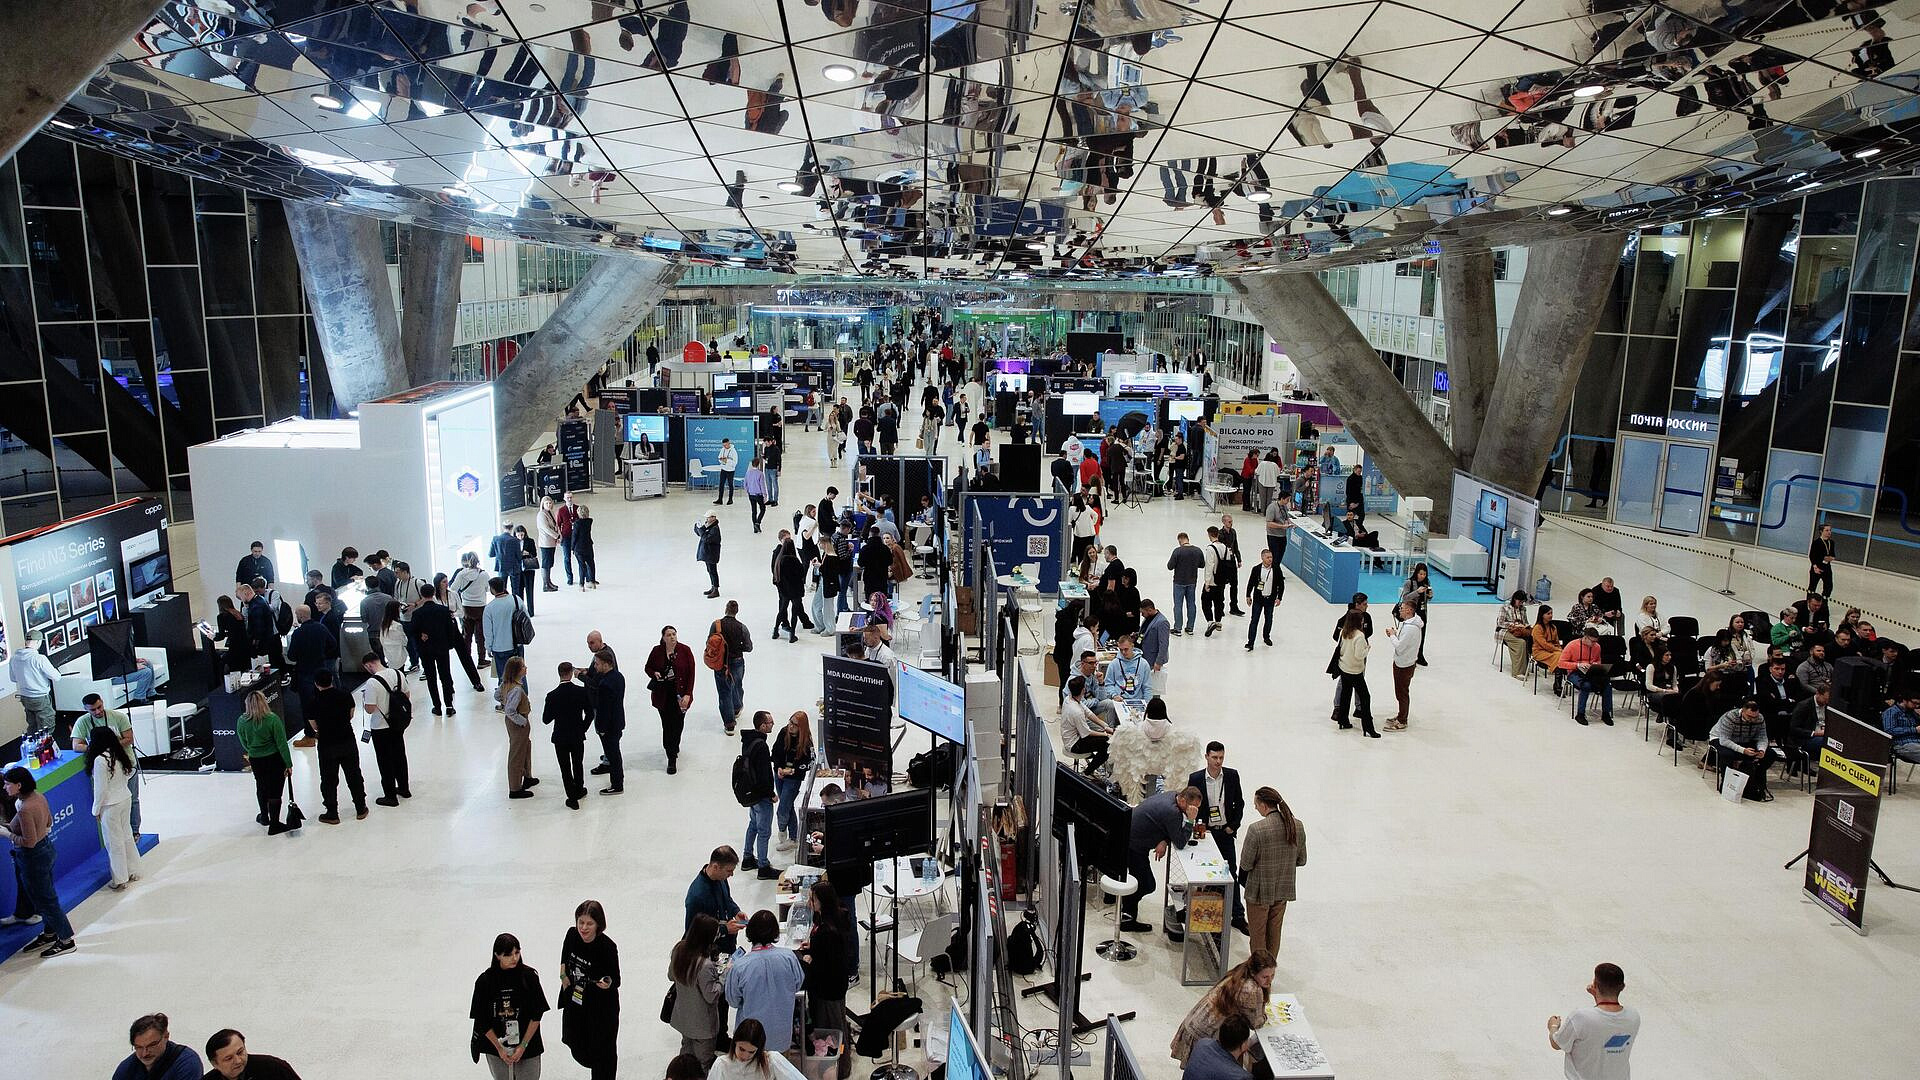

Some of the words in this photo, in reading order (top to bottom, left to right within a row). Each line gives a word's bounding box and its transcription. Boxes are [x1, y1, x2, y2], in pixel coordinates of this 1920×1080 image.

[1219, 428, 1255, 436] BILGANO
[1630, 414, 1663, 427] ПОЧТА
[1666, 417, 1708, 432] РОССИИ
[145, 503, 162, 516] oppo
[17, 553, 47, 578] Find
[48, 544, 66, 566] N3
[68, 536, 106, 561] Series
[841, 672, 885, 686] КОНСАЛТИНГ
[1825, 754, 1847, 772] DEMO
[1848, 768, 1876, 788] СЦЕНА
[1814, 872, 1857, 911] WEEK
[1816, 861, 1858, 899] TECH
